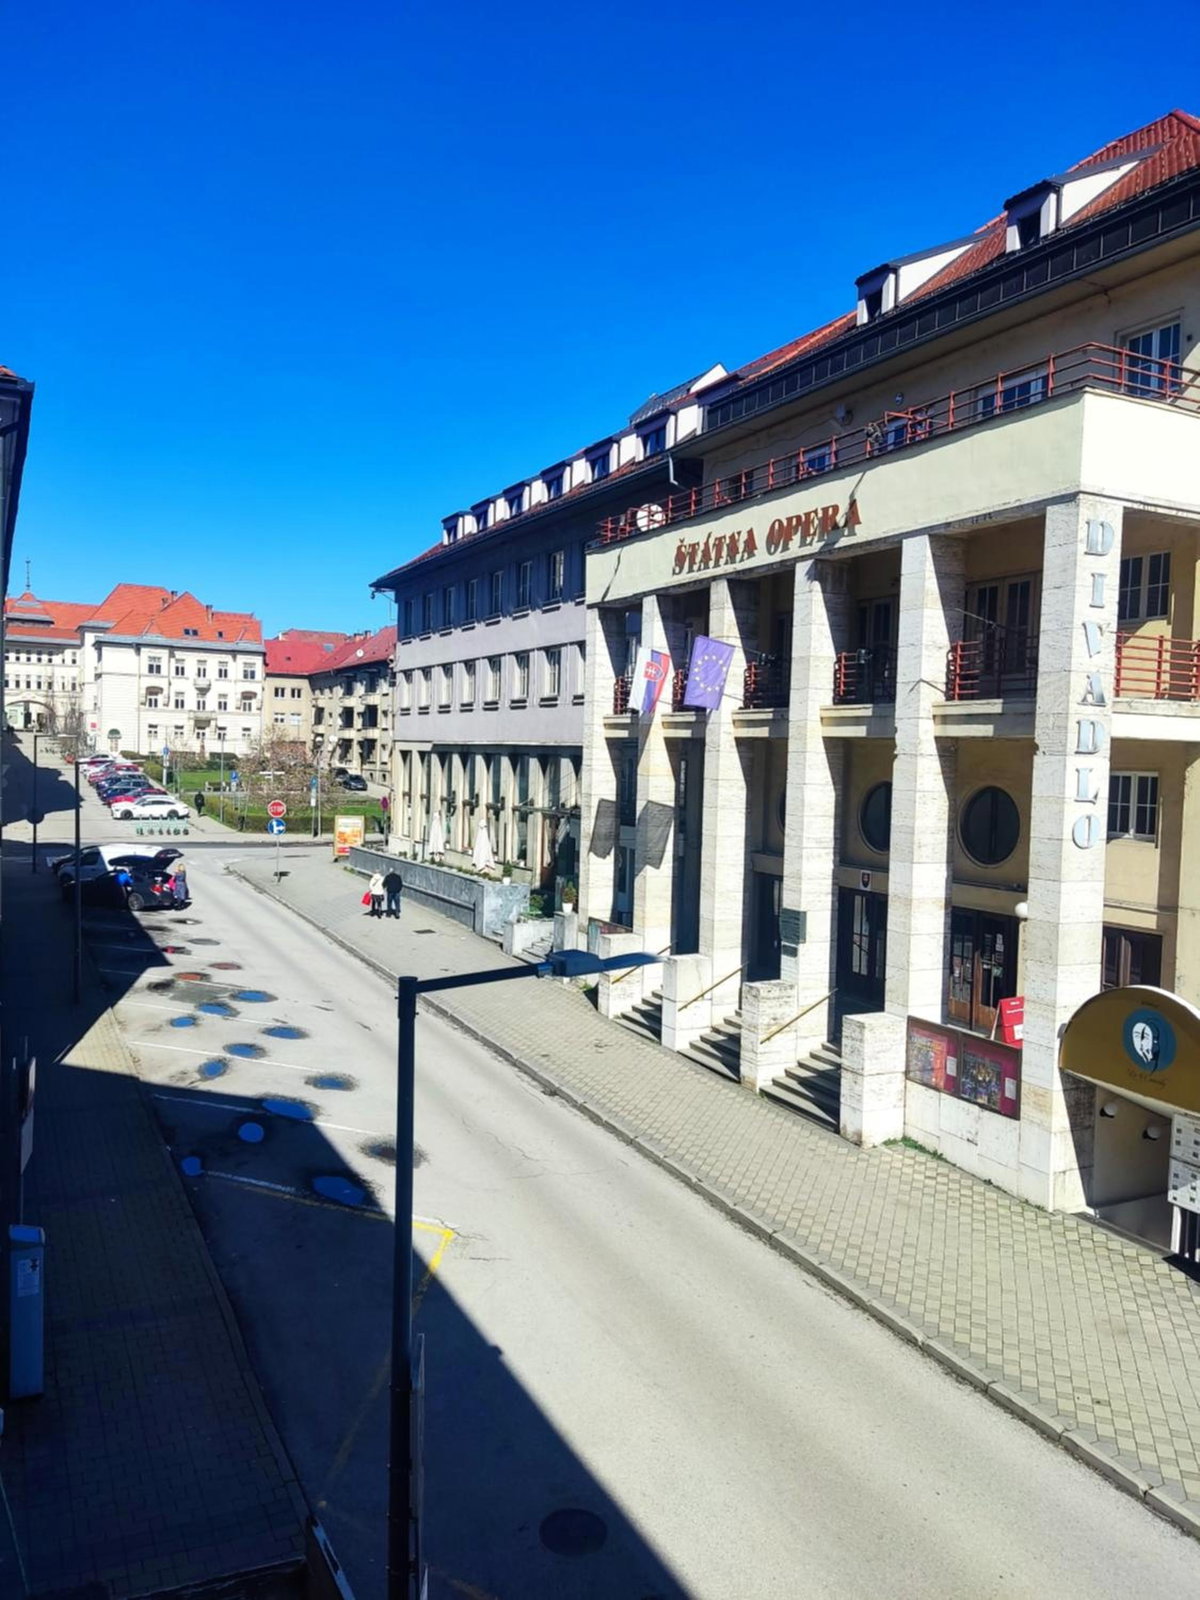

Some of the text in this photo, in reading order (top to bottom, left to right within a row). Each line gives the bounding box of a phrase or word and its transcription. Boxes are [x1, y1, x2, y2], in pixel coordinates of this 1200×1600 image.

[674, 500, 862, 574] ŠTÁTNA OPERA
[1072, 519, 1114, 850] DIVADLO
[269, 806, 285, 814] STOP
